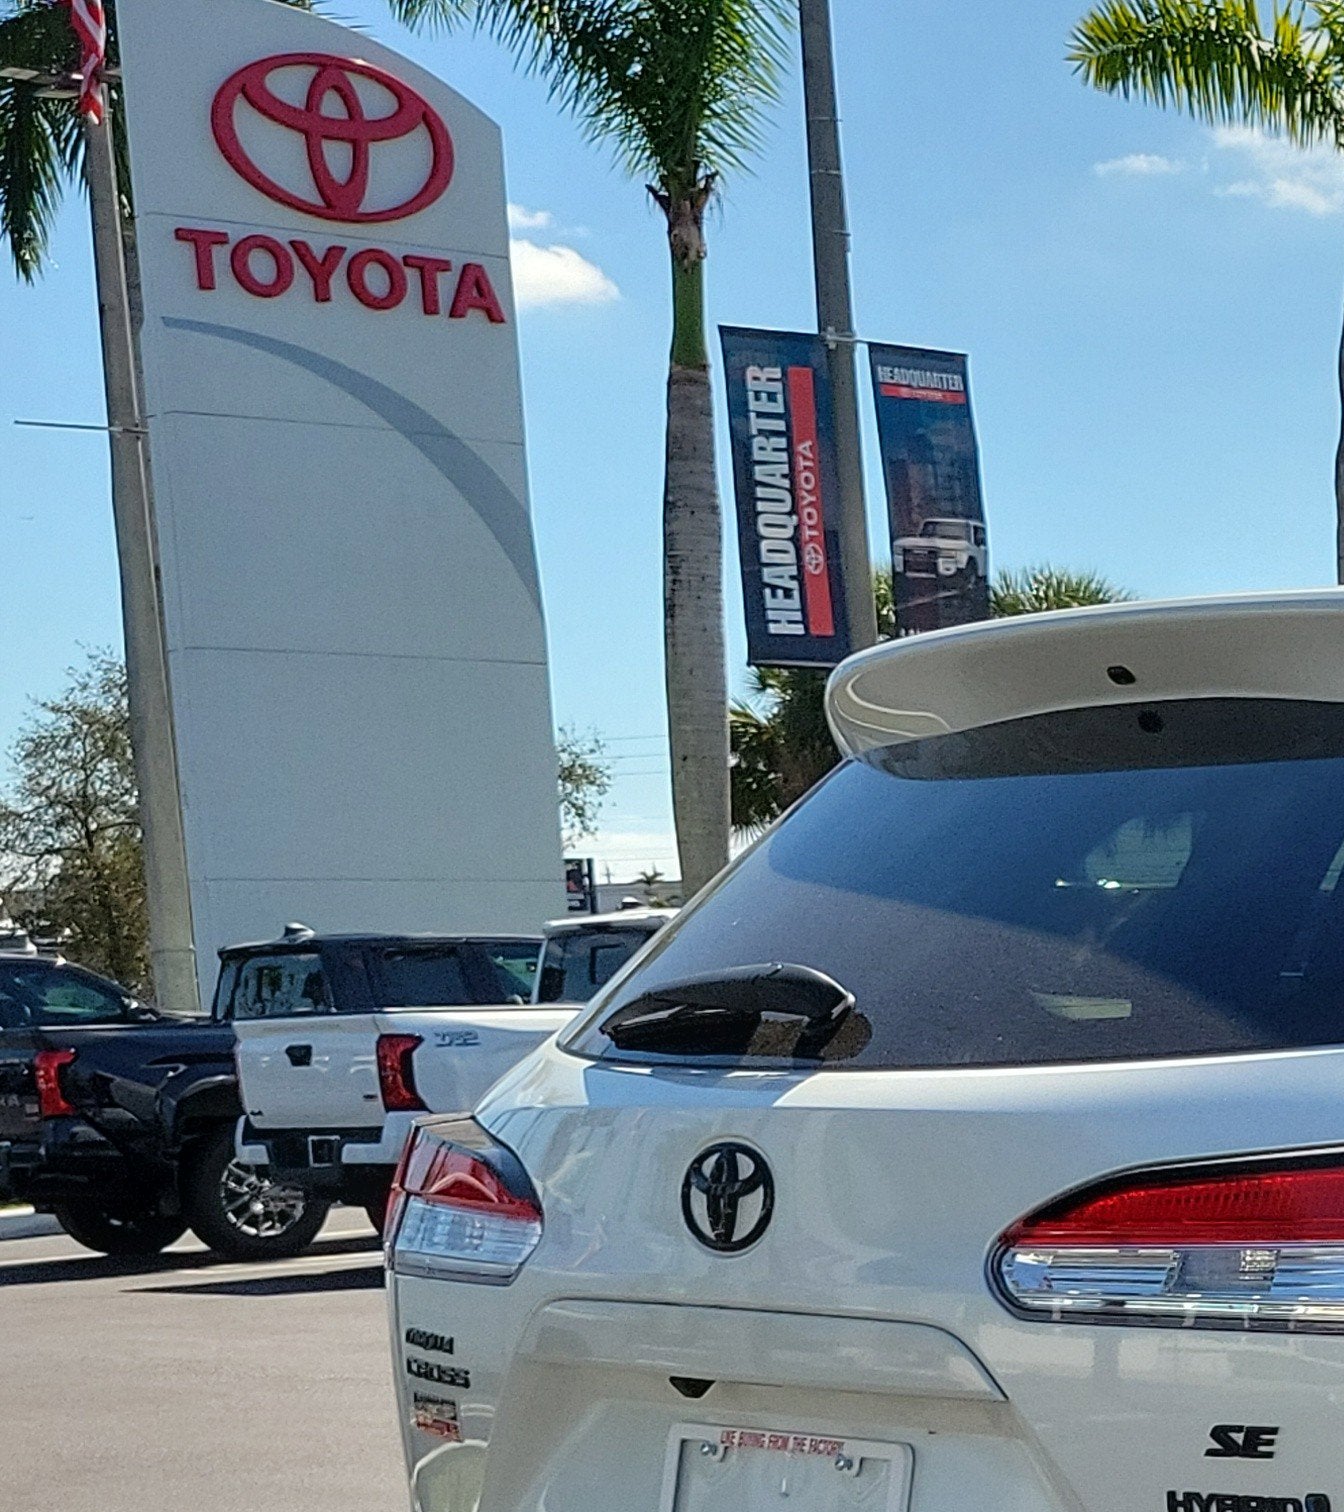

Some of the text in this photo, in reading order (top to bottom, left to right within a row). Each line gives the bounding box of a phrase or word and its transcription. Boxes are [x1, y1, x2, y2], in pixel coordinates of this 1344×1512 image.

[174, 227, 506, 324] TOYOTA
[877, 365, 964, 391] HEADQUARTER
[747, 366, 805, 635] HEADQUARTER
[797, 440, 820, 539] TOYOTA
[1204, 1424, 1279, 1459] SE
